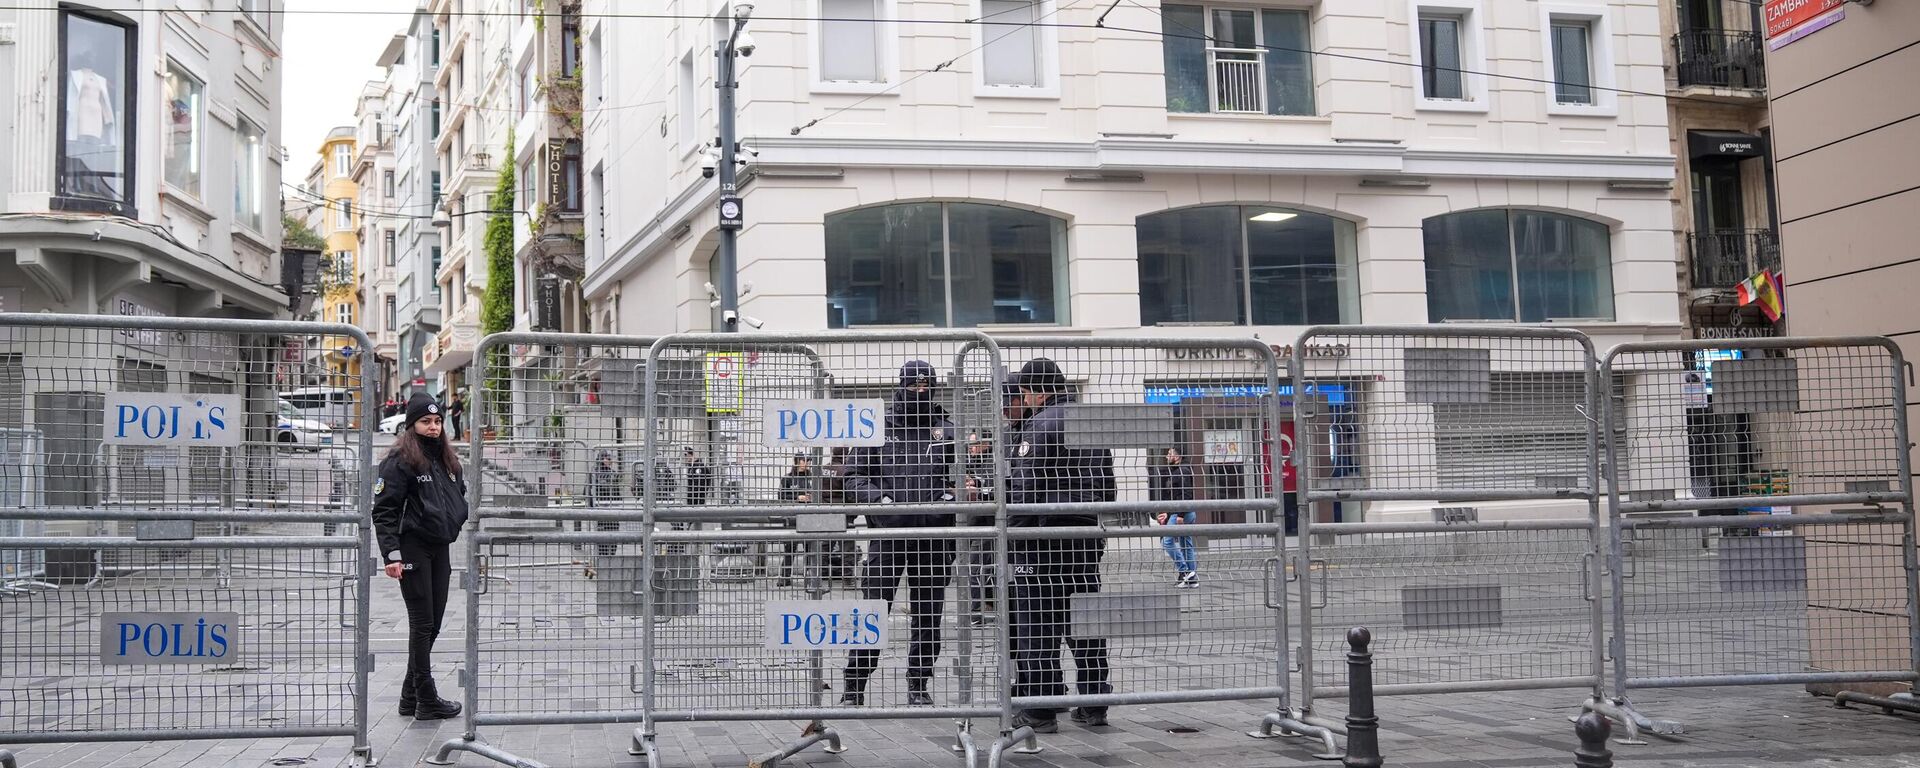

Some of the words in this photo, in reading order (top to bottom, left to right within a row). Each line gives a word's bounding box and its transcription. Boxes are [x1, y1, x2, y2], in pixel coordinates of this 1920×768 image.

[550, 151, 560, 205] HOTEL
[545, 289, 553, 328] HOTEL
[1700, 327, 1738, 339] BONNE
[777, 403, 876, 440] POLİS
[116, 617, 229, 658] POLİS
[780, 607, 881, 646] POLİS
